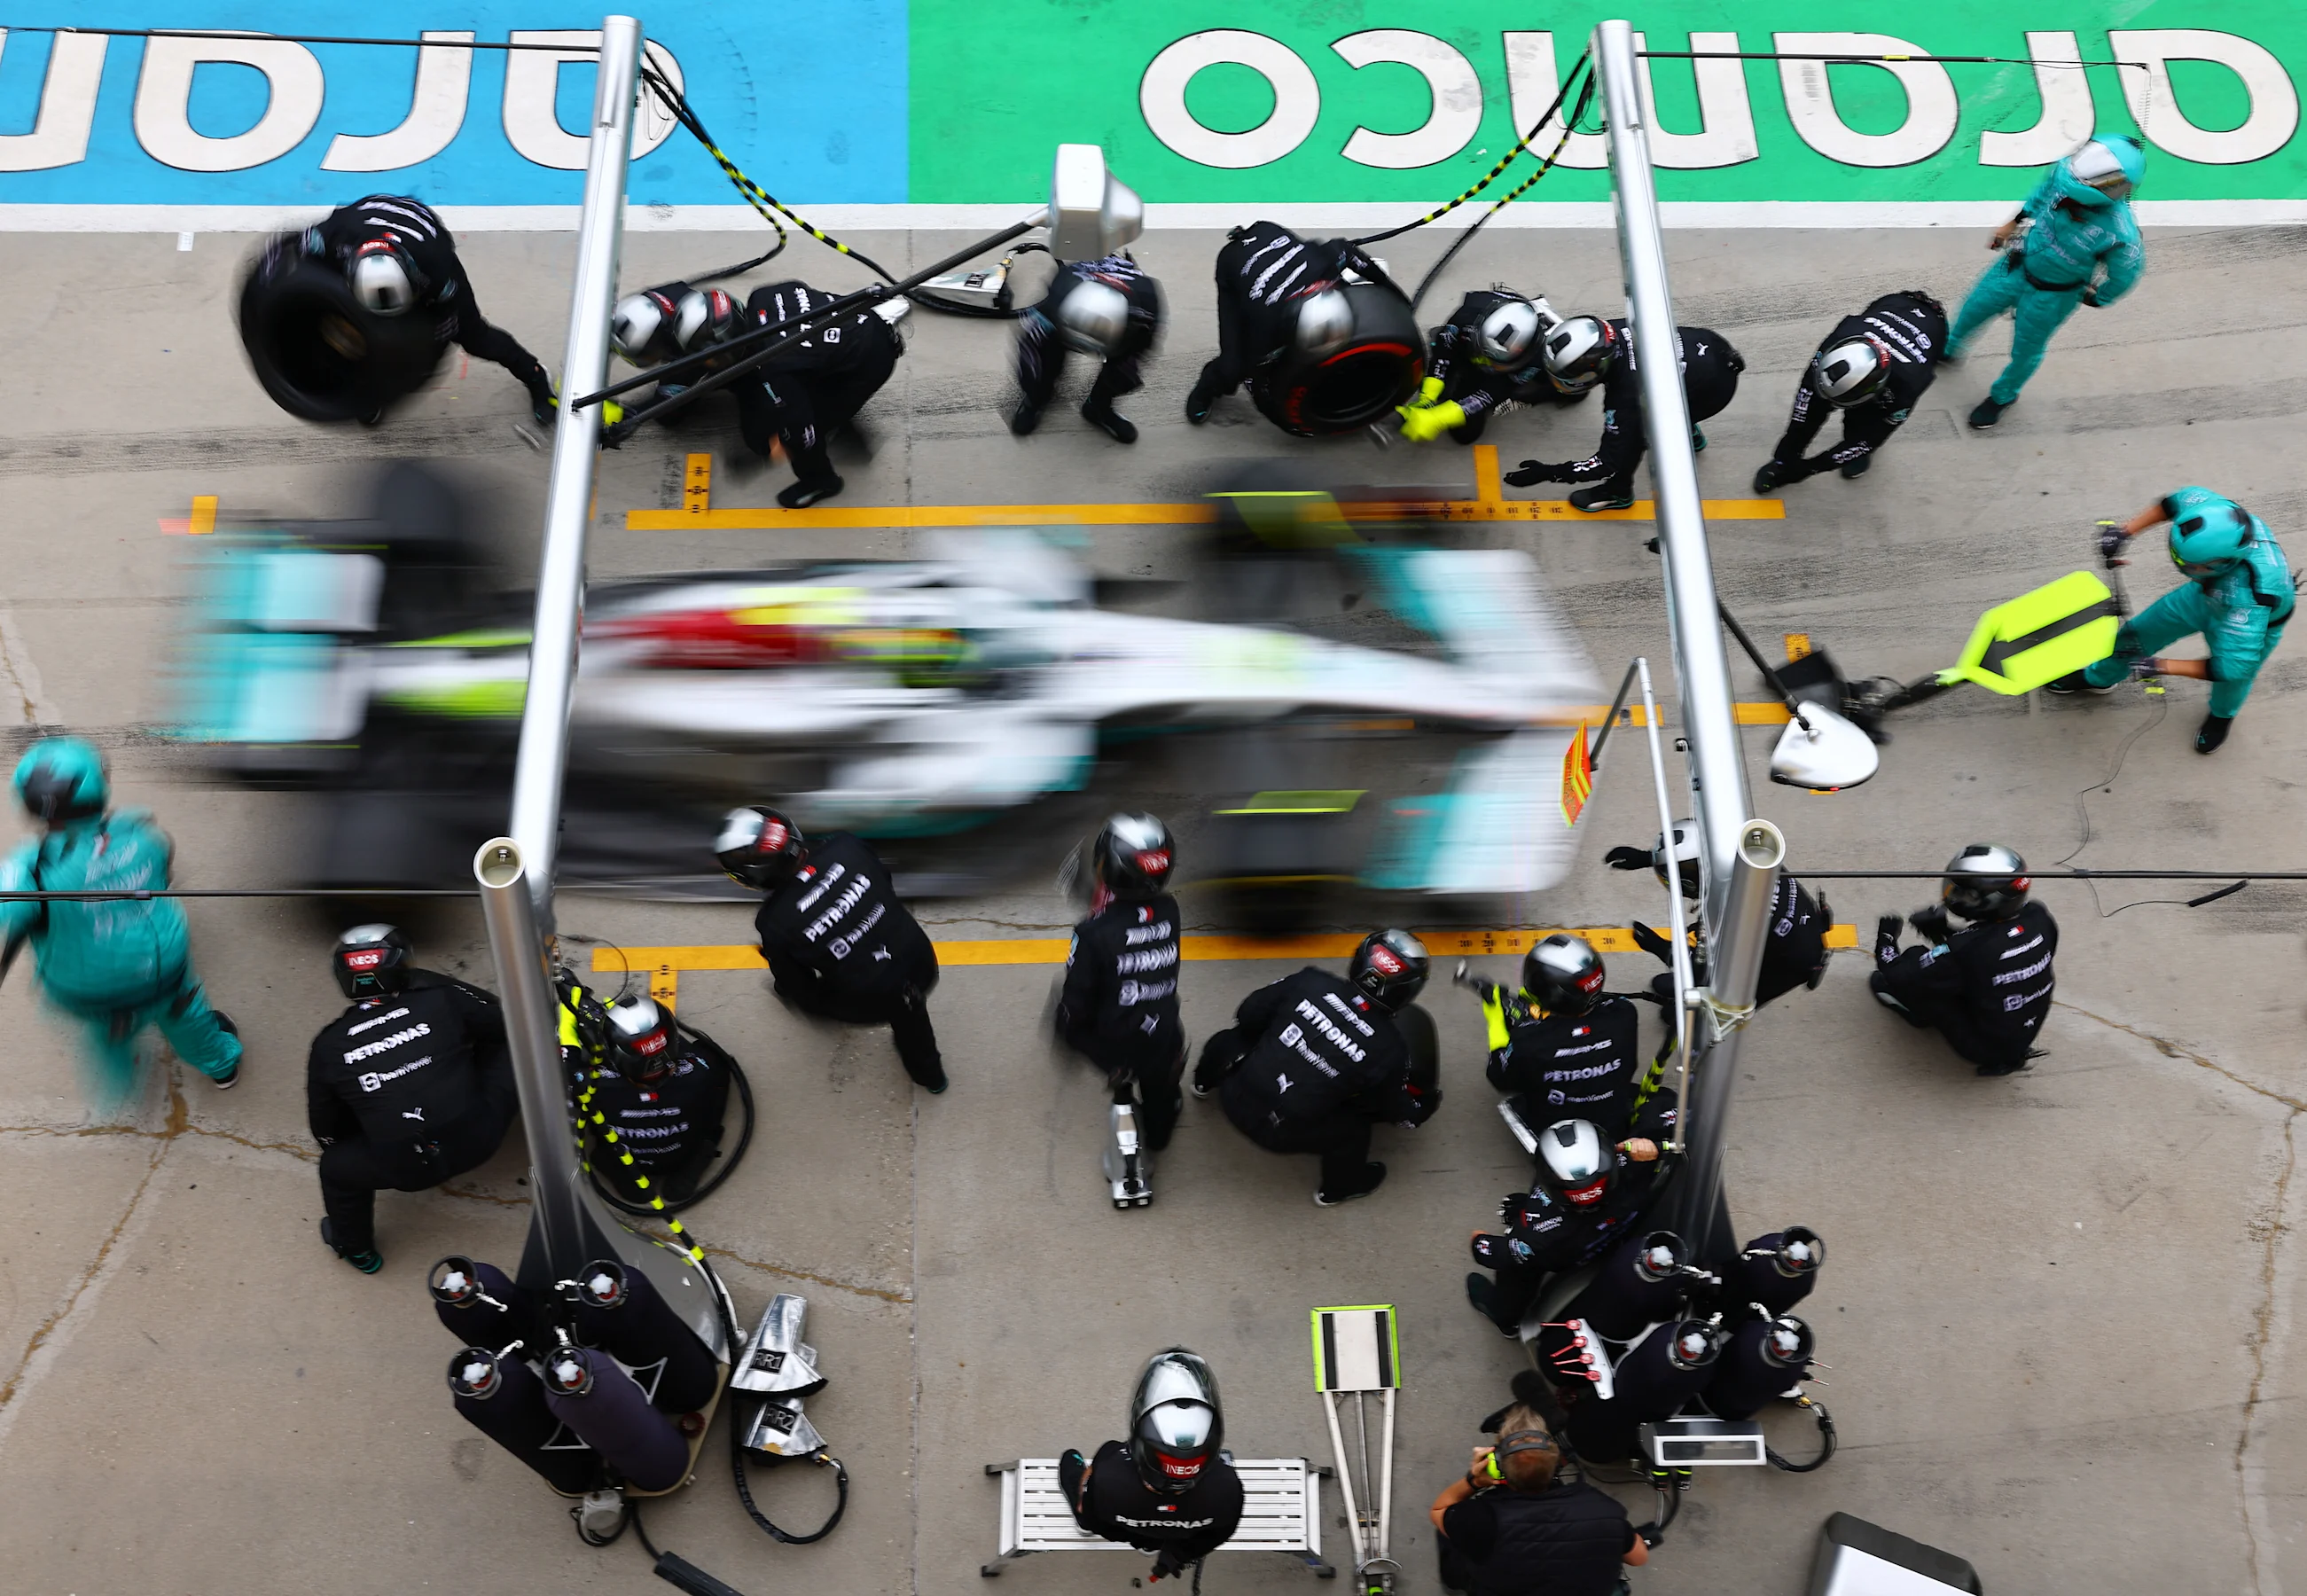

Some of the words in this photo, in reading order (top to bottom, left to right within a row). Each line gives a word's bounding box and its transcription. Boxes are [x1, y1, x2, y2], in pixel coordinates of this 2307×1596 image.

[1140, 28, 2299, 169] aramco
[1864, 317, 1928, 364] PETRONAS
[802, 873, 872, 943] PETRONAS
[348, 954, 379, 966] INEOS
[1294, 998, 1367, 1063] PETRONAS
[343, 1022, 431, 1065] PETRONAS
[1544, 1059, 1622, 1082] PETRONAS
[1569, 1186, 1603, 1202] INEOS
[754, 1352, 782, 1370] RR1
[764, 1408, 795, 1430] RR2
[1165, 1464, 1200, 1476] INEOS
[1115, 1514, 1214, 1530] PETRONAS
